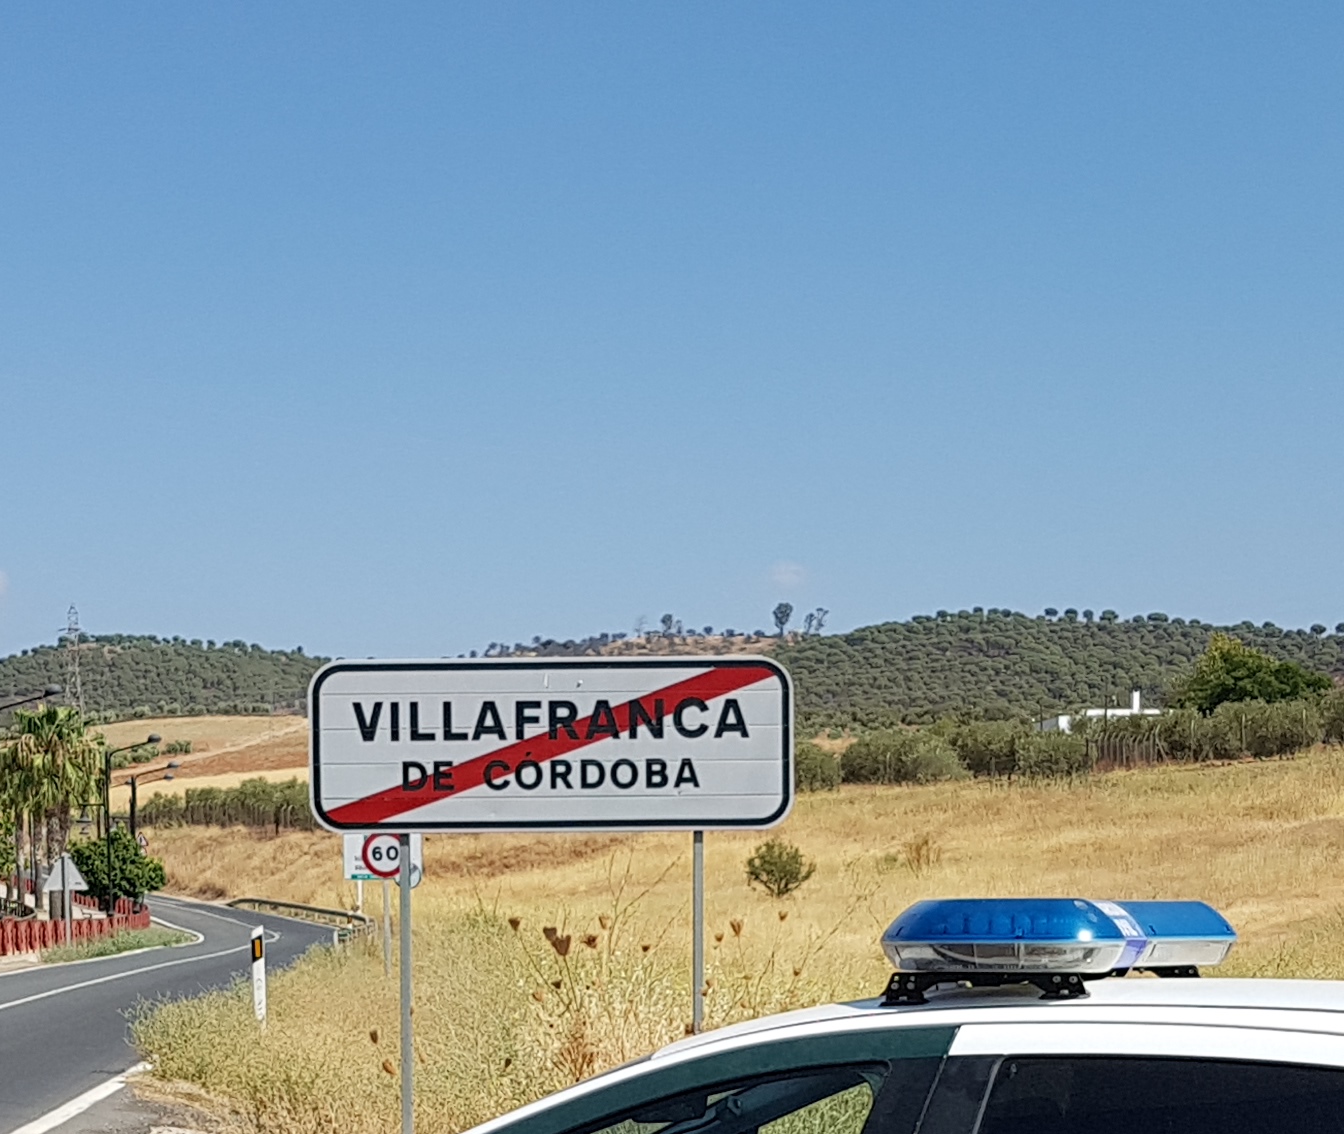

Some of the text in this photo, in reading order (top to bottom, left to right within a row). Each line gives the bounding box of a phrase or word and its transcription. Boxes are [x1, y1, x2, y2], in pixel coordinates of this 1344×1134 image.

[352, 696, 750, 742] VILLAFRANCA
[402, 751, 700, 791] DE CÓRDOBA
[372, 846, 399, 861] 60
